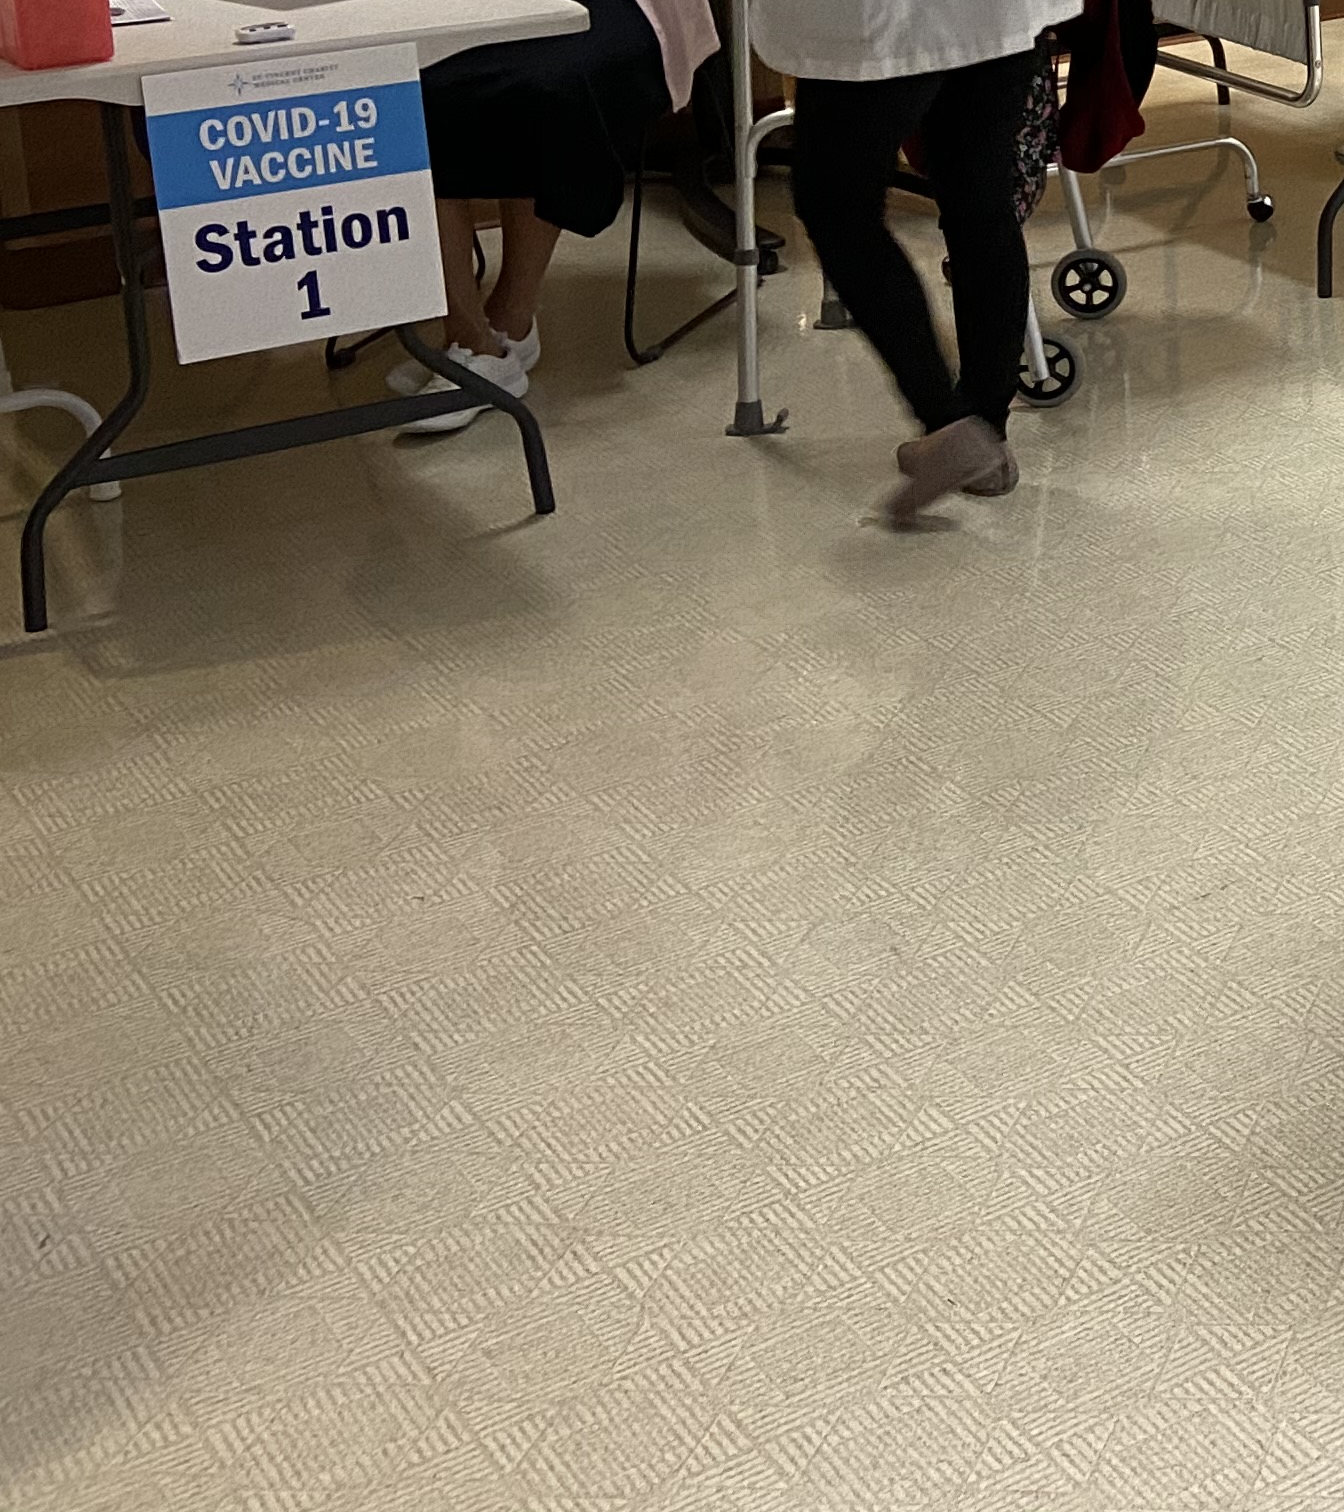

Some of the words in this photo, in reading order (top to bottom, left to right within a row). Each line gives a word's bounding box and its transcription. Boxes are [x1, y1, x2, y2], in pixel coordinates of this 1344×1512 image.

[199, 98, 378, 151] COVID-19
[209, 137, 378, 190] VACCINE
[194, 205, 410, 273] Station
[297, 270, 331, 320] 1
